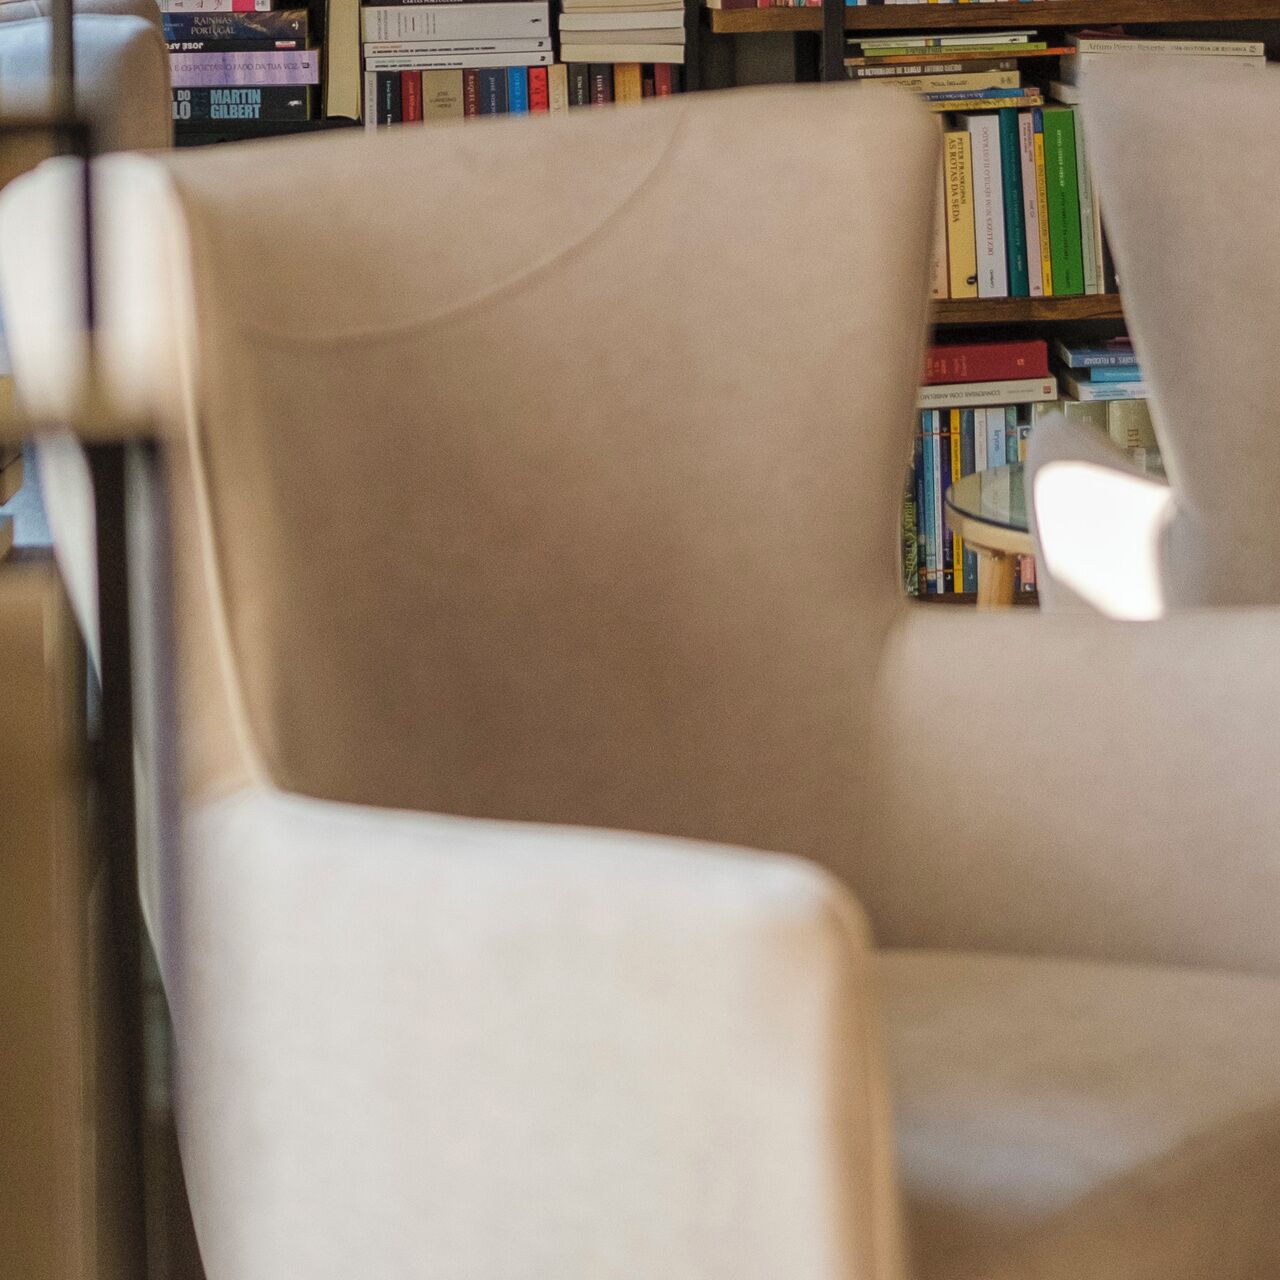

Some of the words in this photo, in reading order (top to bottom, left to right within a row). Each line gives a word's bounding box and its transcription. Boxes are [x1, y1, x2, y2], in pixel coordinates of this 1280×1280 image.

[194, 16, 231, 25] RAINHAS
[191, 26, 235, 34] PORTUGAL
[211, 89, 260, 104] MARTIN
[211, 105, 260, 118] GILBERT
[948, 139, 956, 149] AS
[949, 152, 957, 182] ROTAS
[950, 184, 958, 195] DA
[950, 199, 958, 222] SEDA
